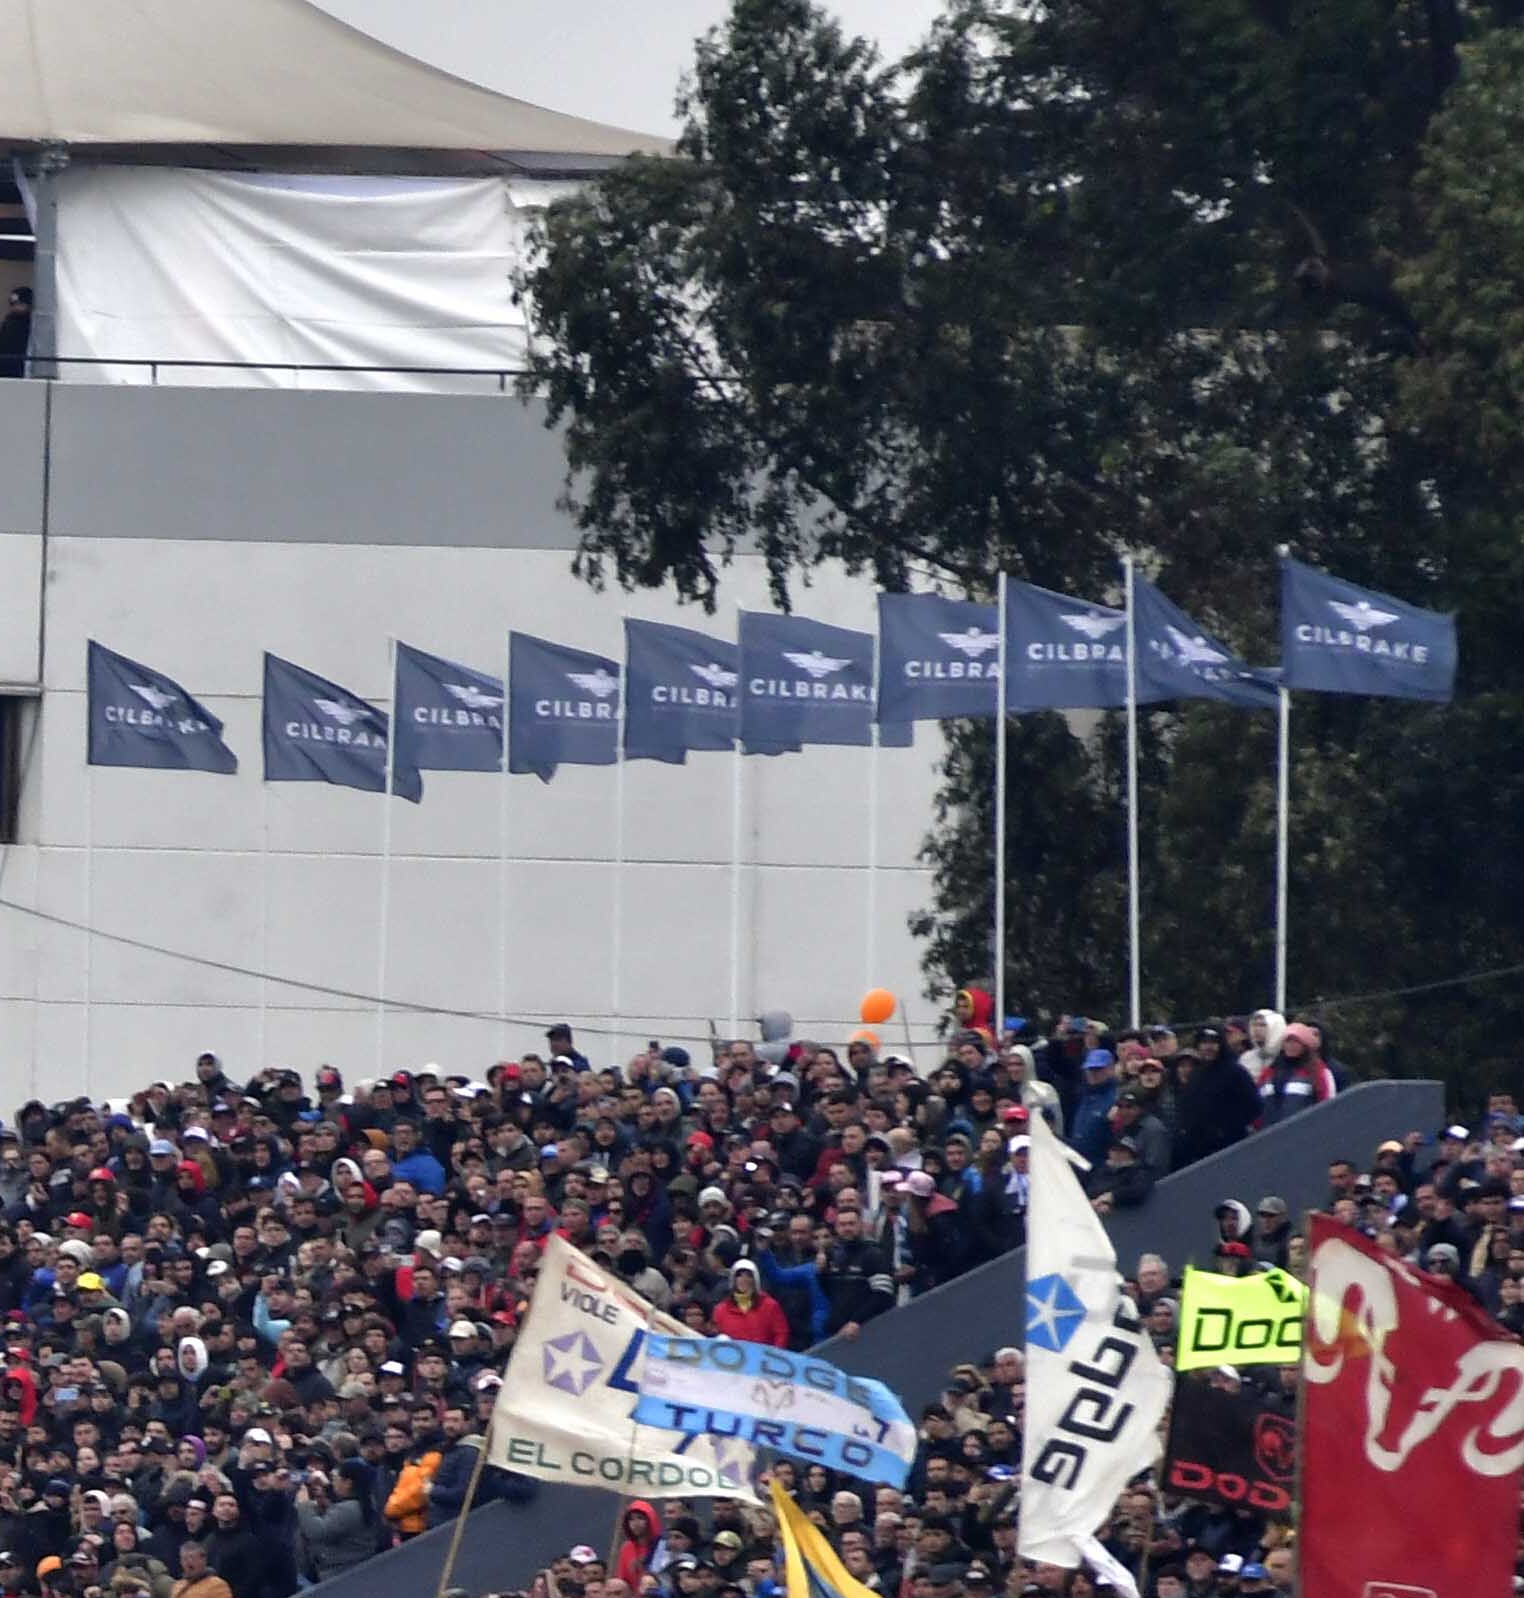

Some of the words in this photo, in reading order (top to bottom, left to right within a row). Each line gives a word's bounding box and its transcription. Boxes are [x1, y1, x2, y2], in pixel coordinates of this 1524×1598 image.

[1296, 623, 1430, 664] CILBRAKE
[508, 1436, 561, 1471] EL
[665, 1402, 874, 1469] TURCO
